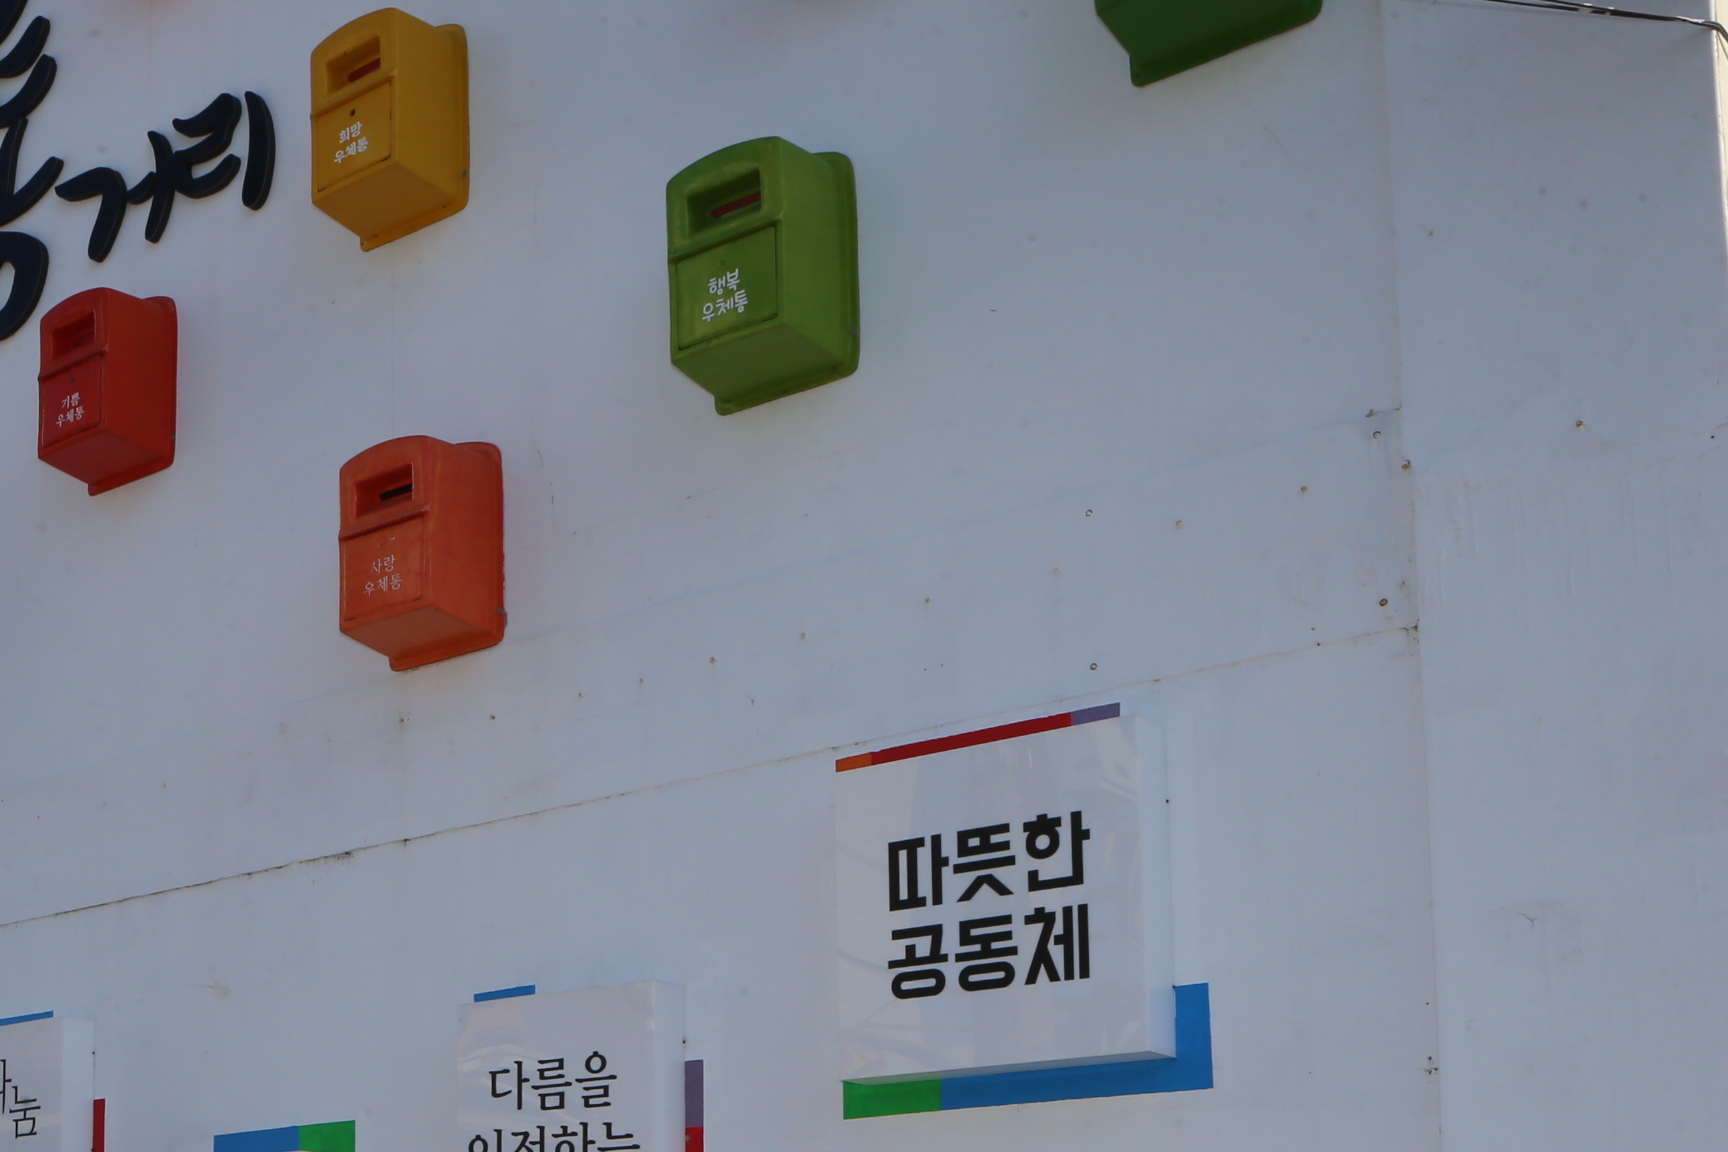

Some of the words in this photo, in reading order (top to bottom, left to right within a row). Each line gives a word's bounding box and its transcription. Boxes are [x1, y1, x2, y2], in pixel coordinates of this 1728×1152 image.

[338, 121, 363, 144] 희망
[333, 136, 369, 164] 우체통
[708, 268, 741, 296] 행복
[702, 289, 749, 322] 우체통
[61, 391, 81, 410] 기쁨
[56, 405, 85, 428] 우체통
[372, 554, 396, 575] 사랑
[363, 573, 403, 597] 우체통
[887, 810, 1091, 912] 따뜻한
[887, 903, 1091, 1000] 공동체
[488, 1050, 618, 1111] 다름을
